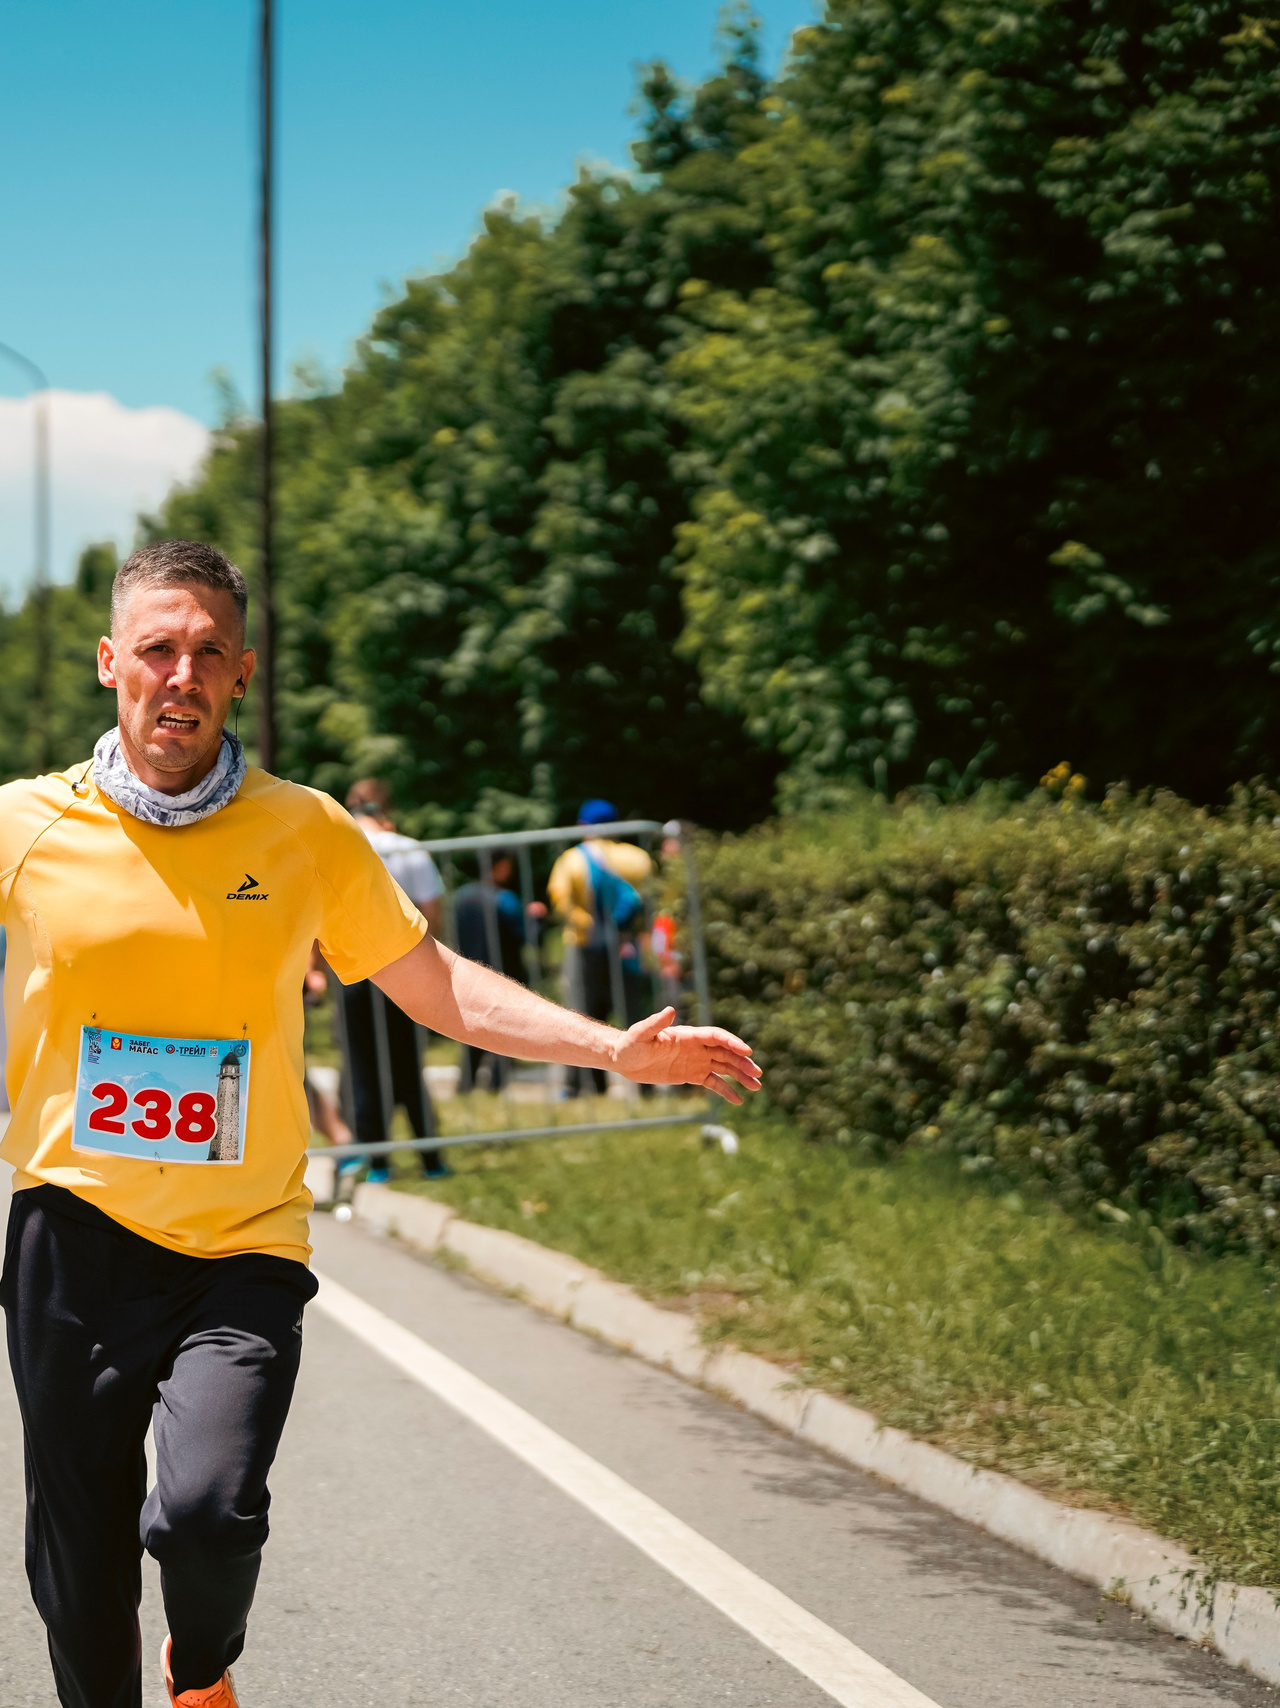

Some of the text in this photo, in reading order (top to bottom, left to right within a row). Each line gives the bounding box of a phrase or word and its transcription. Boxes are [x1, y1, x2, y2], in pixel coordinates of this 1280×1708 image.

[129, 1039, 150, 1047] ЗАБЕГ
[129, 1045, 159, 1055] МАГАС
[89, 1082, 216, 1143] 238
